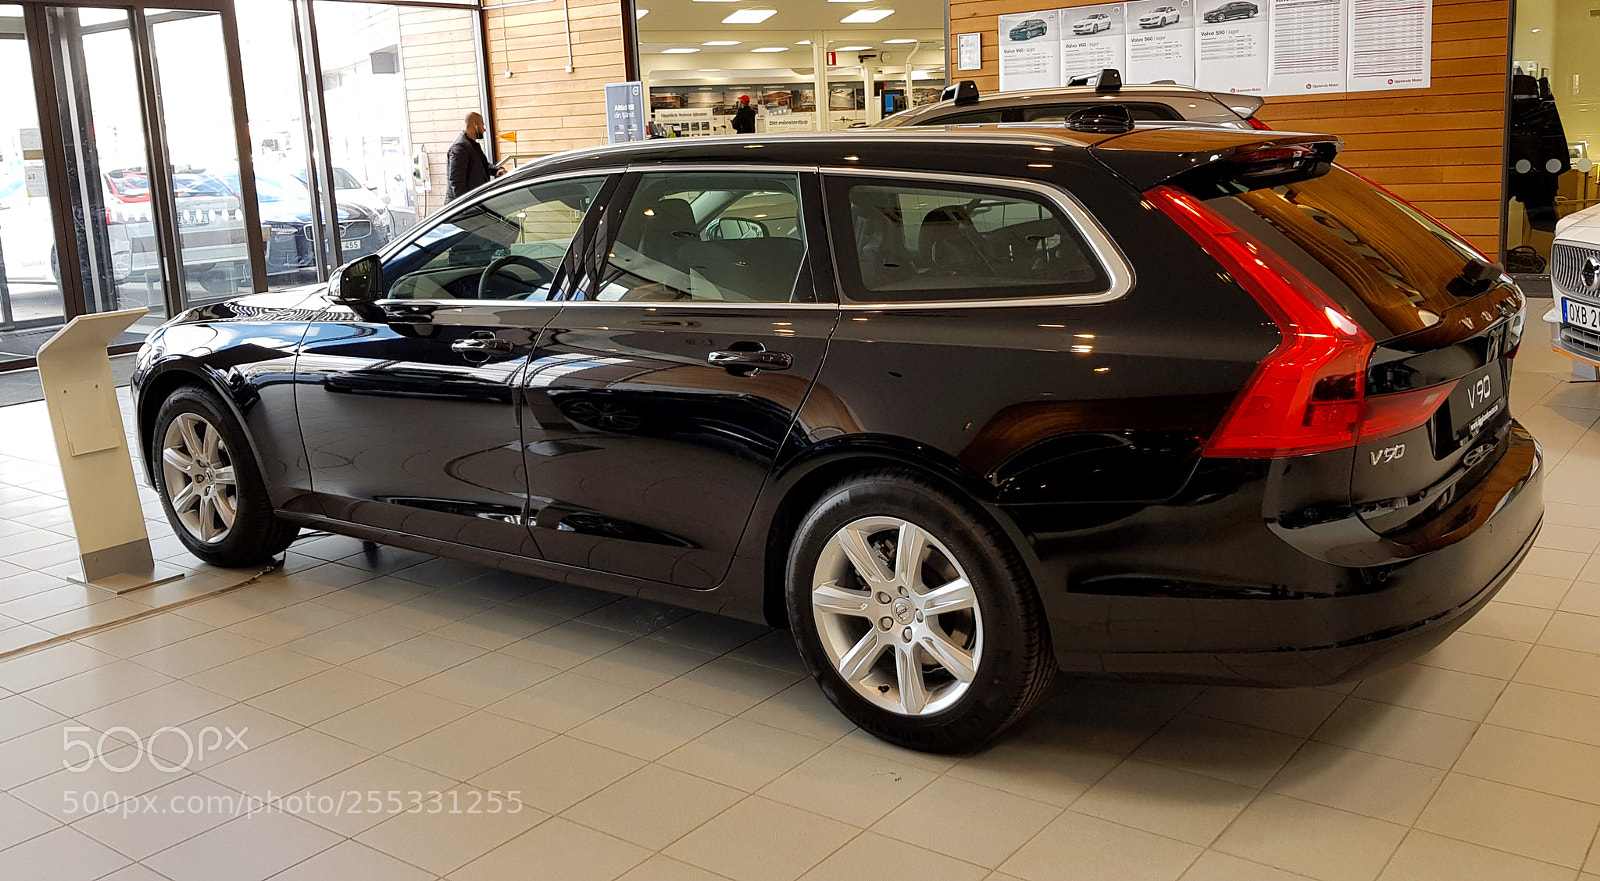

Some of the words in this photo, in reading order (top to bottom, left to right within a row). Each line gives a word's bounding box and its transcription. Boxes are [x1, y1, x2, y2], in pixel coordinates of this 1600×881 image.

[1569, 303, 1587, 325] OXB
[1467, 374, 1491, 409] V90
[1370, 444, 1405, 466] V90
